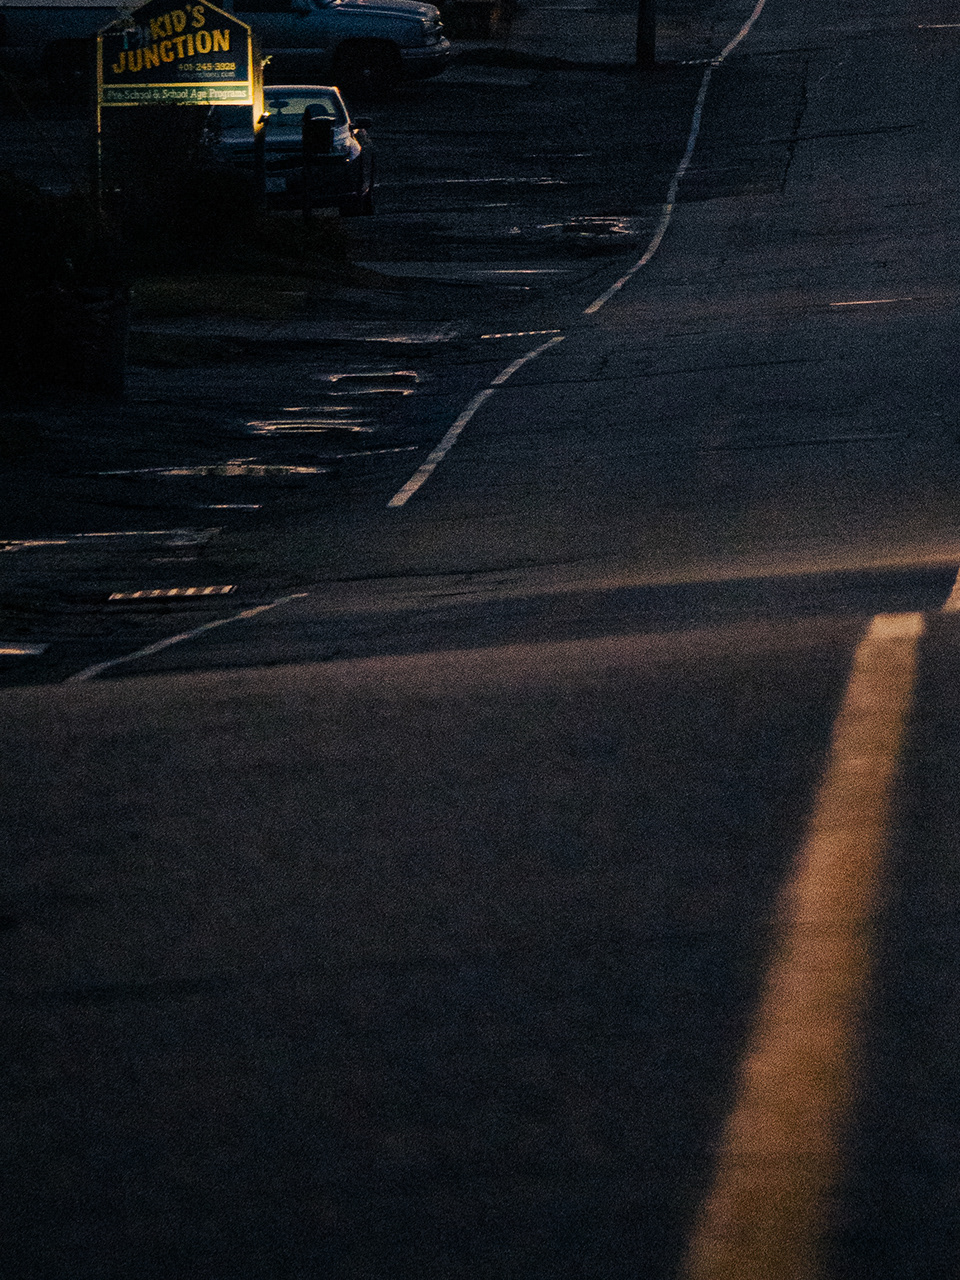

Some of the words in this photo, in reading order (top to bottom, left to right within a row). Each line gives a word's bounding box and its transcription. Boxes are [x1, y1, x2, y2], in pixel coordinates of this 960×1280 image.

[149, 4, 206, 40] KID'S
[112, 29, 231, 74] JUNCTION
[162, 89, 188, 99] School
[190, 89, 207, 100] Age
[209, 88, 247, 100] Programs
